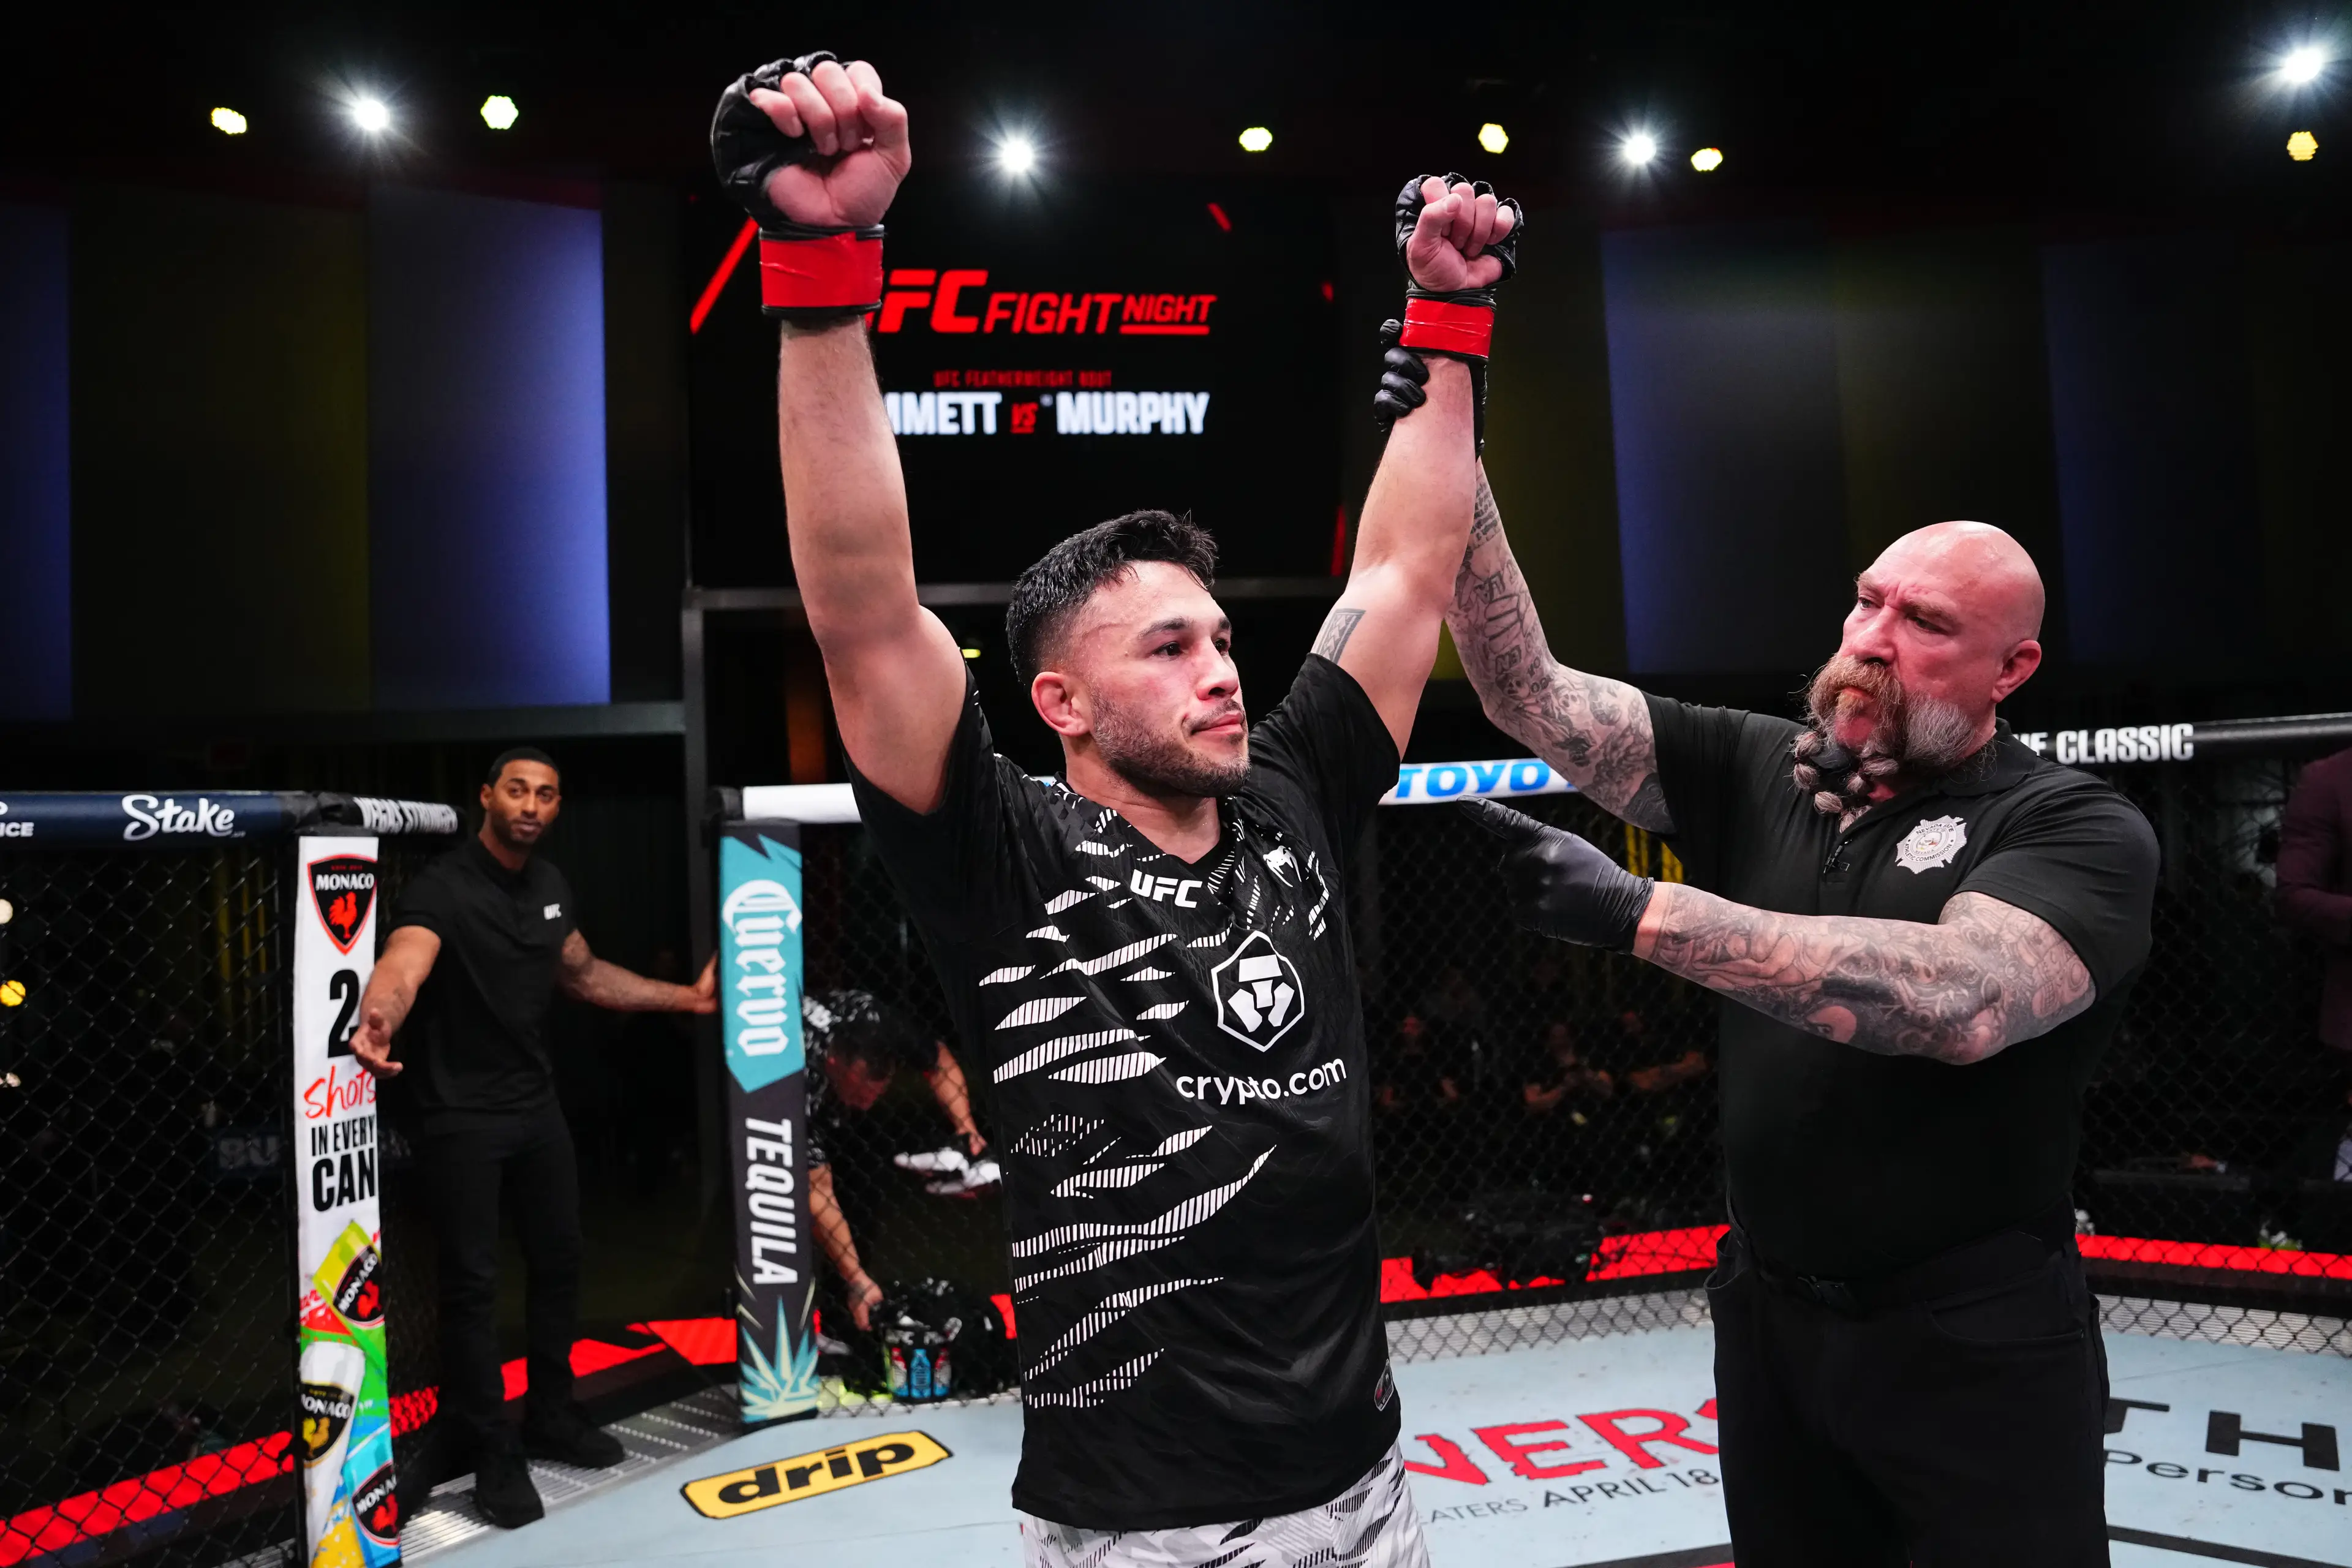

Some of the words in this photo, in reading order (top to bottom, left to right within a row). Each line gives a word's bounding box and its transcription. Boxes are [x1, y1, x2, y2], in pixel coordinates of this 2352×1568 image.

[864, 270, 988, 333] FC
[984, 293, 1122, 333] FIGHT
[1122, 295, 1217, 323] NIGHT
[1011, 402, 1038, 428] VS
[1055, 391, 1210, 434] MURPHY
[2056, 722, 2195, 765] CLASSIC
[121, 794, 235, 841] Stake
[1916, 823, 1942, 835] NEVADA
[1904, 843, 1916, 861] ATHLETIC
[1915, 843, 1953, 862] COMMISSION
[315, 873, 375, 891] MONACO
[1130, 869, 1202, 908] UFC
[723, 879, 802, 1057] Cuervo
[328, 968, 360, 1059] 2
[1176, 1058, 1348, 1105] crypto.com
[311, 1126, 328, 1156] IN
[334, 1115, 375, 1152] EVERY
[312, 1147, 375, 1212] CAN
[745, 1117, 798, 1284] TEQUILA
[337, 1253, 378, 1314] MONACO
[718, 1443, 915, 1504] drip
[1543, 1478, 1667, 1508] APRIL
[1667, 1469, 1720, 1488] 18
